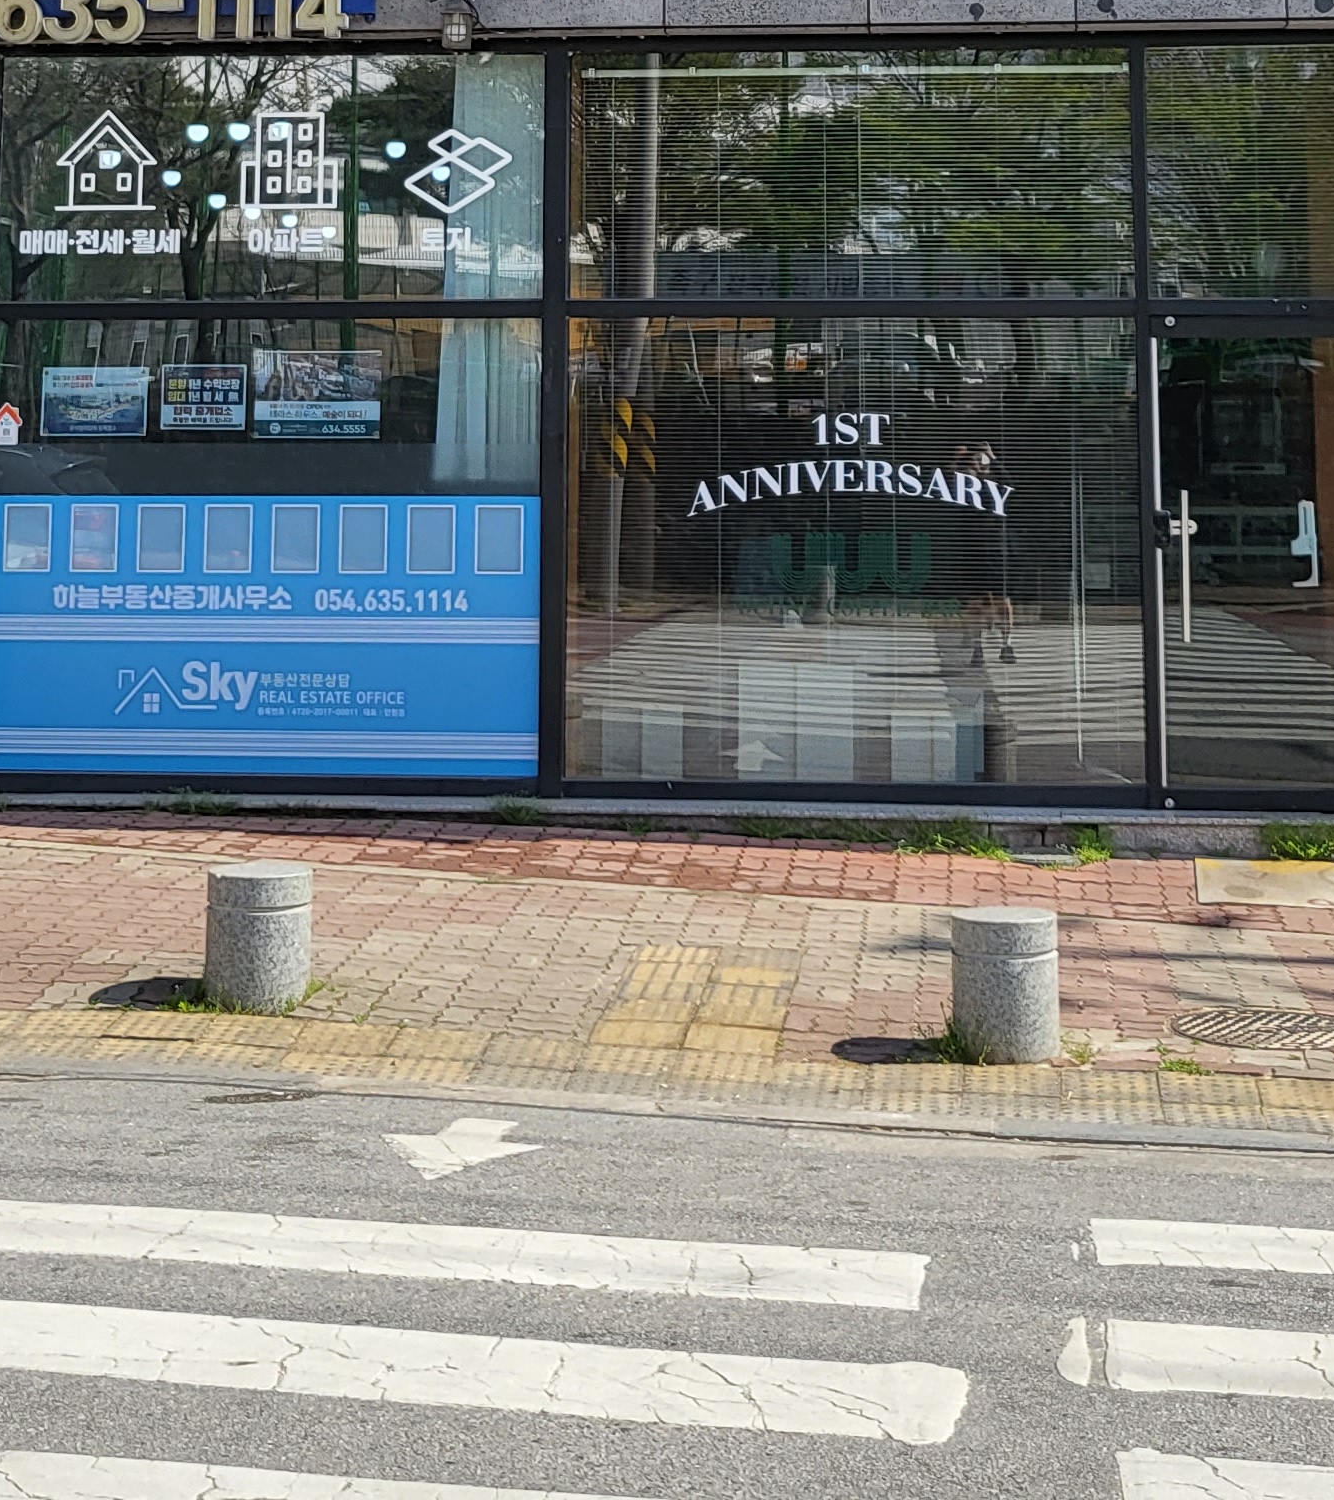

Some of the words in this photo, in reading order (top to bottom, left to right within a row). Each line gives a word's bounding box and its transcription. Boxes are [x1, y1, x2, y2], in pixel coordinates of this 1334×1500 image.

[248, 228, 327, 255] 아파트
[420, 227, 472, 253] 토지
[811, 412, 891, 446] 1ST
[687, 459, 1015, 517] ANNIVERSARY
[53, 583, 292, 611] 하늘부동산중개사무소
[315, 588, 469, 613] 054.635.1114
[181, 660, 259, 711] Sky
[259, 672, 351, 688] 부동산전문상담
[258, 690, 296, 705] REAL
[300, 690, 352, 706] ESTATE
[356, 691, 406, 706] OFFICE
